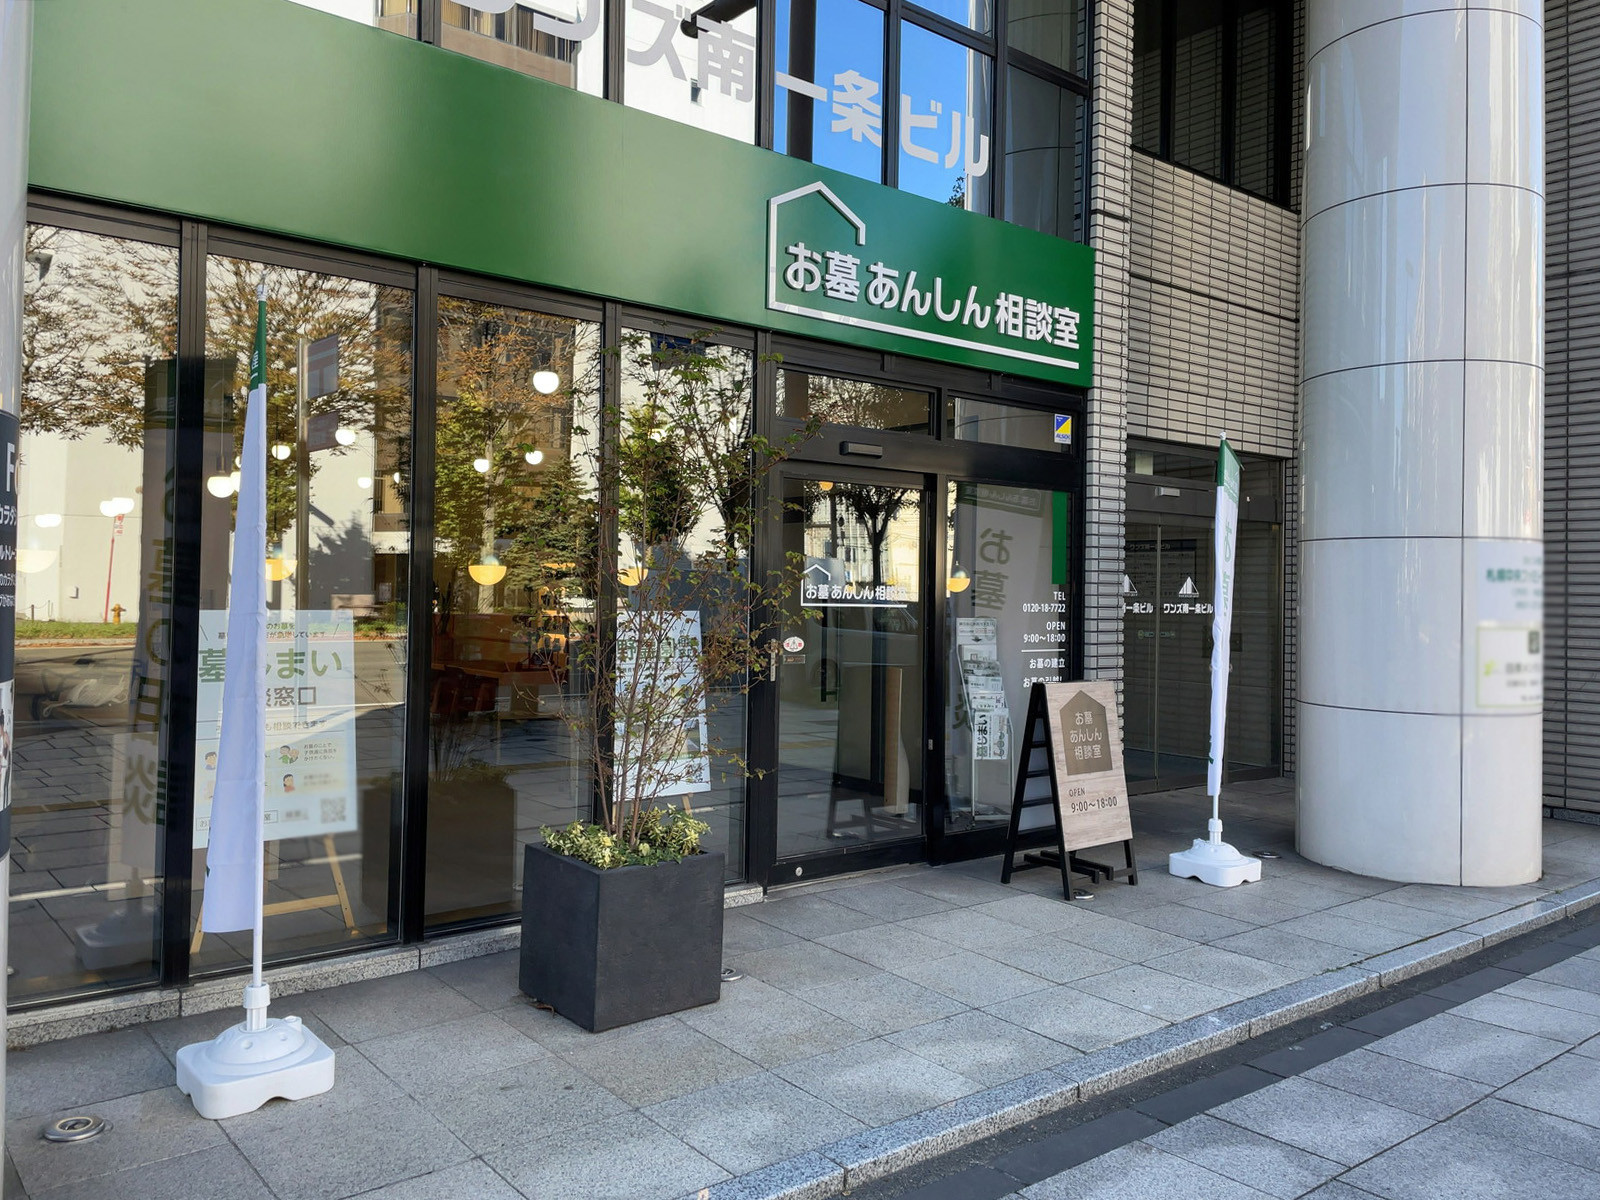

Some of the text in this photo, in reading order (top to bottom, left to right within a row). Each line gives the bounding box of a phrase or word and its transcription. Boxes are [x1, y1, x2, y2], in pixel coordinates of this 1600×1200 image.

[1053, 591, 1066, 600] TEL
[1022, 603, 1066, 613] 0120-18-7722
[1163, 602, 1214, 614] ワンズ南一条ビル
[1046, 621, 1066, 630] OPEN
[1029, 658, 1066, 669] お墓の建立
[1075, 711, 1093, 726] お墓
[1070, 727, 1102, 743] あんしん
[1074, 745, 1102, 760] 相談室
[1069, 787, 1085, 798] OPEN
